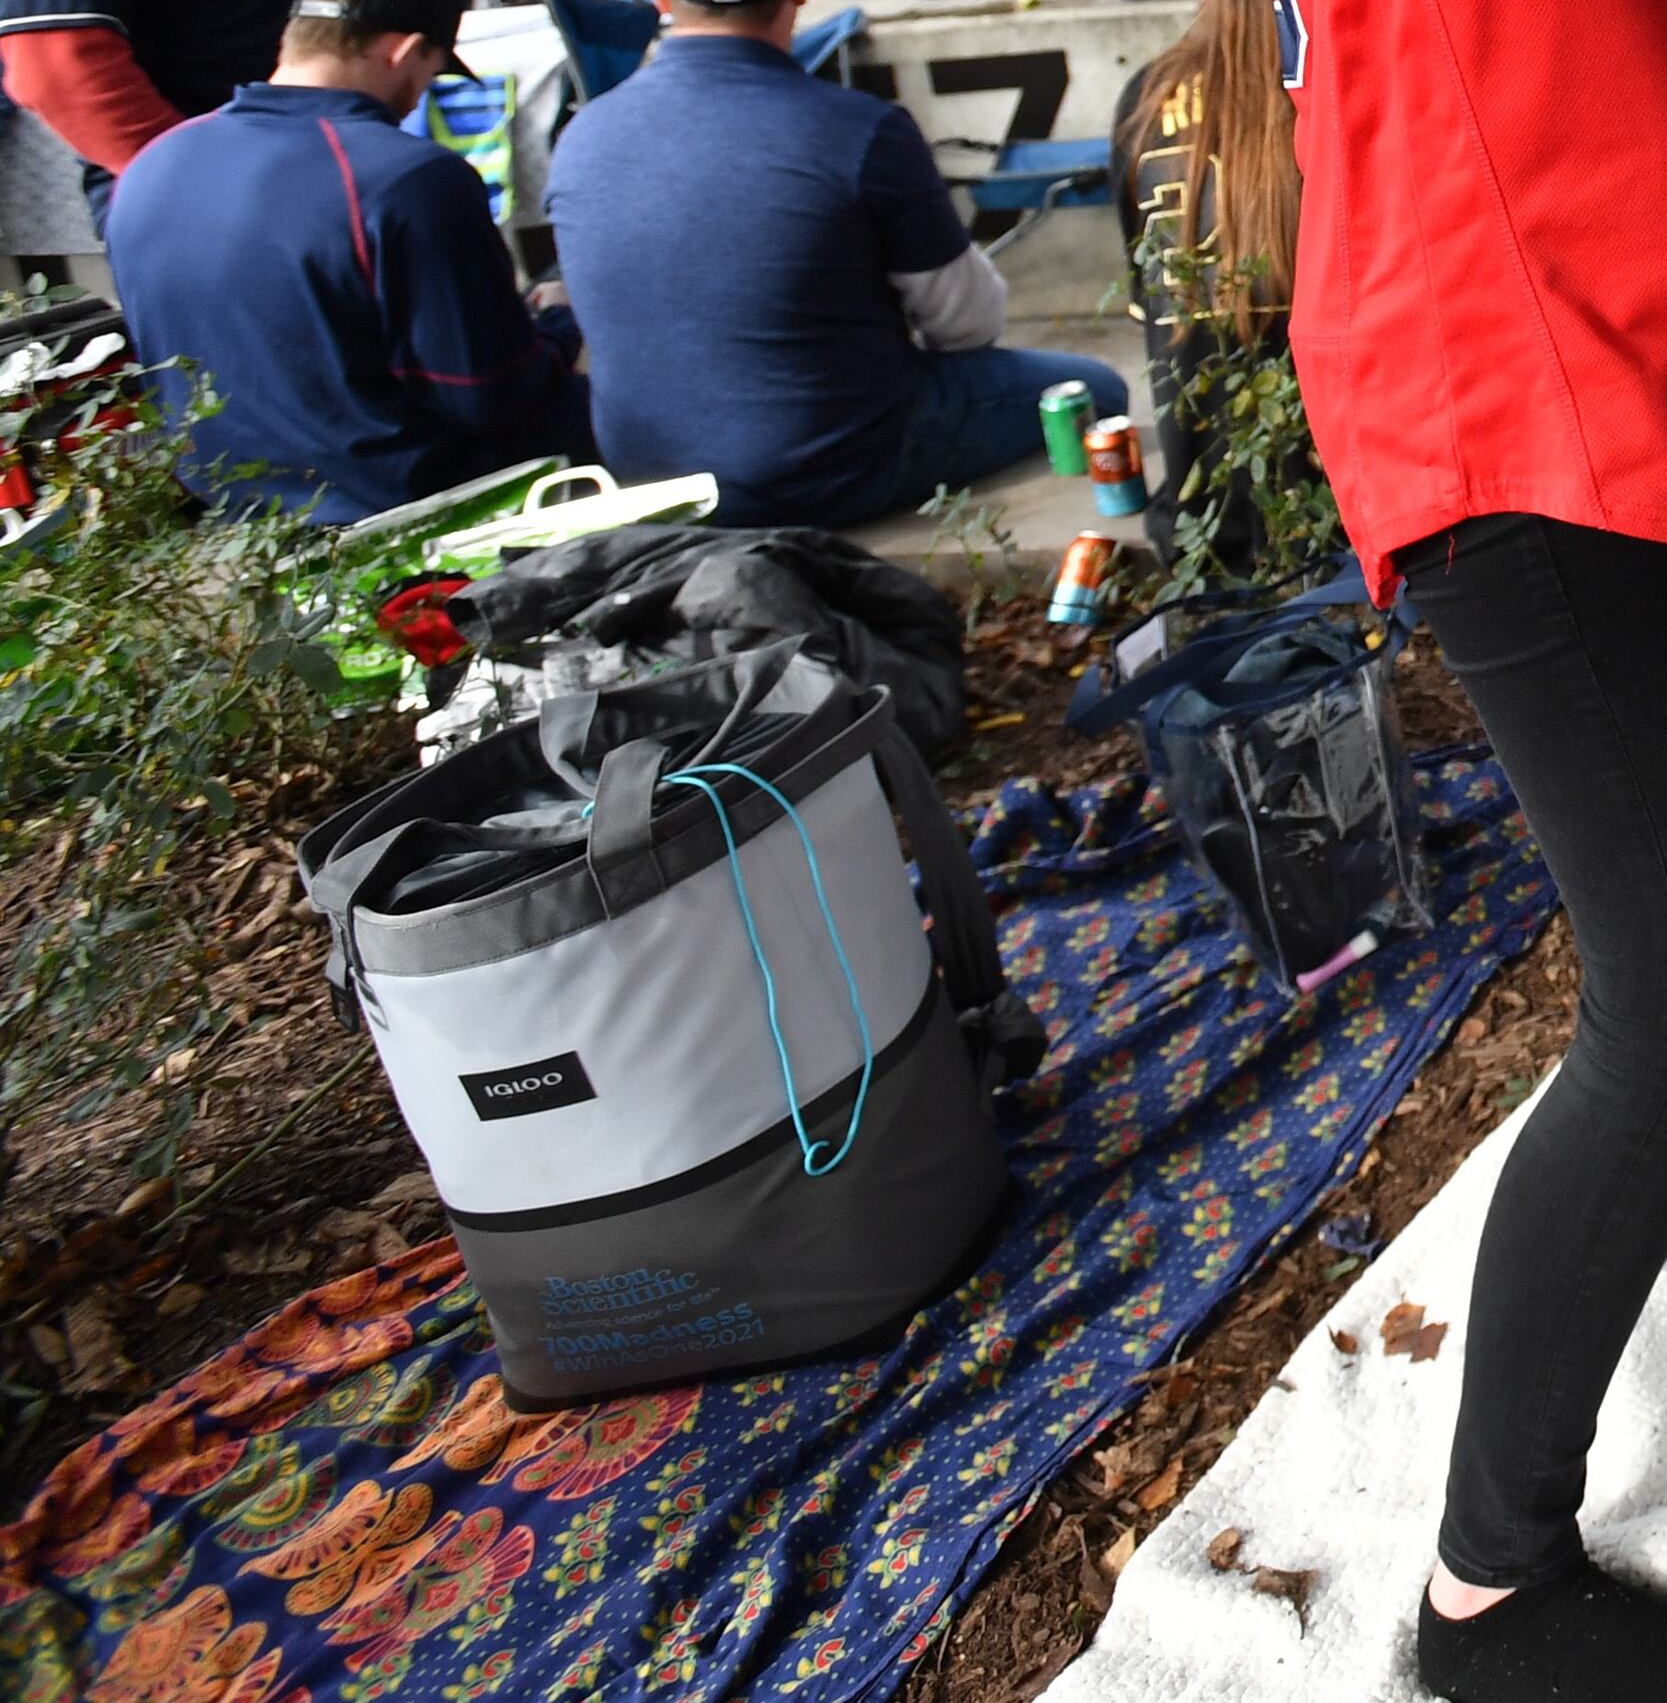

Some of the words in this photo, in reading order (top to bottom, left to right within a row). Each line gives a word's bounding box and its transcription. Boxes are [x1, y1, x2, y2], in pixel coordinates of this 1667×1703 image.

[483, 1068, 563, 1104] IGLOO
[540, 1268, 700, 1315] Scientific
[545, 1267, 652, 1299] Boston
